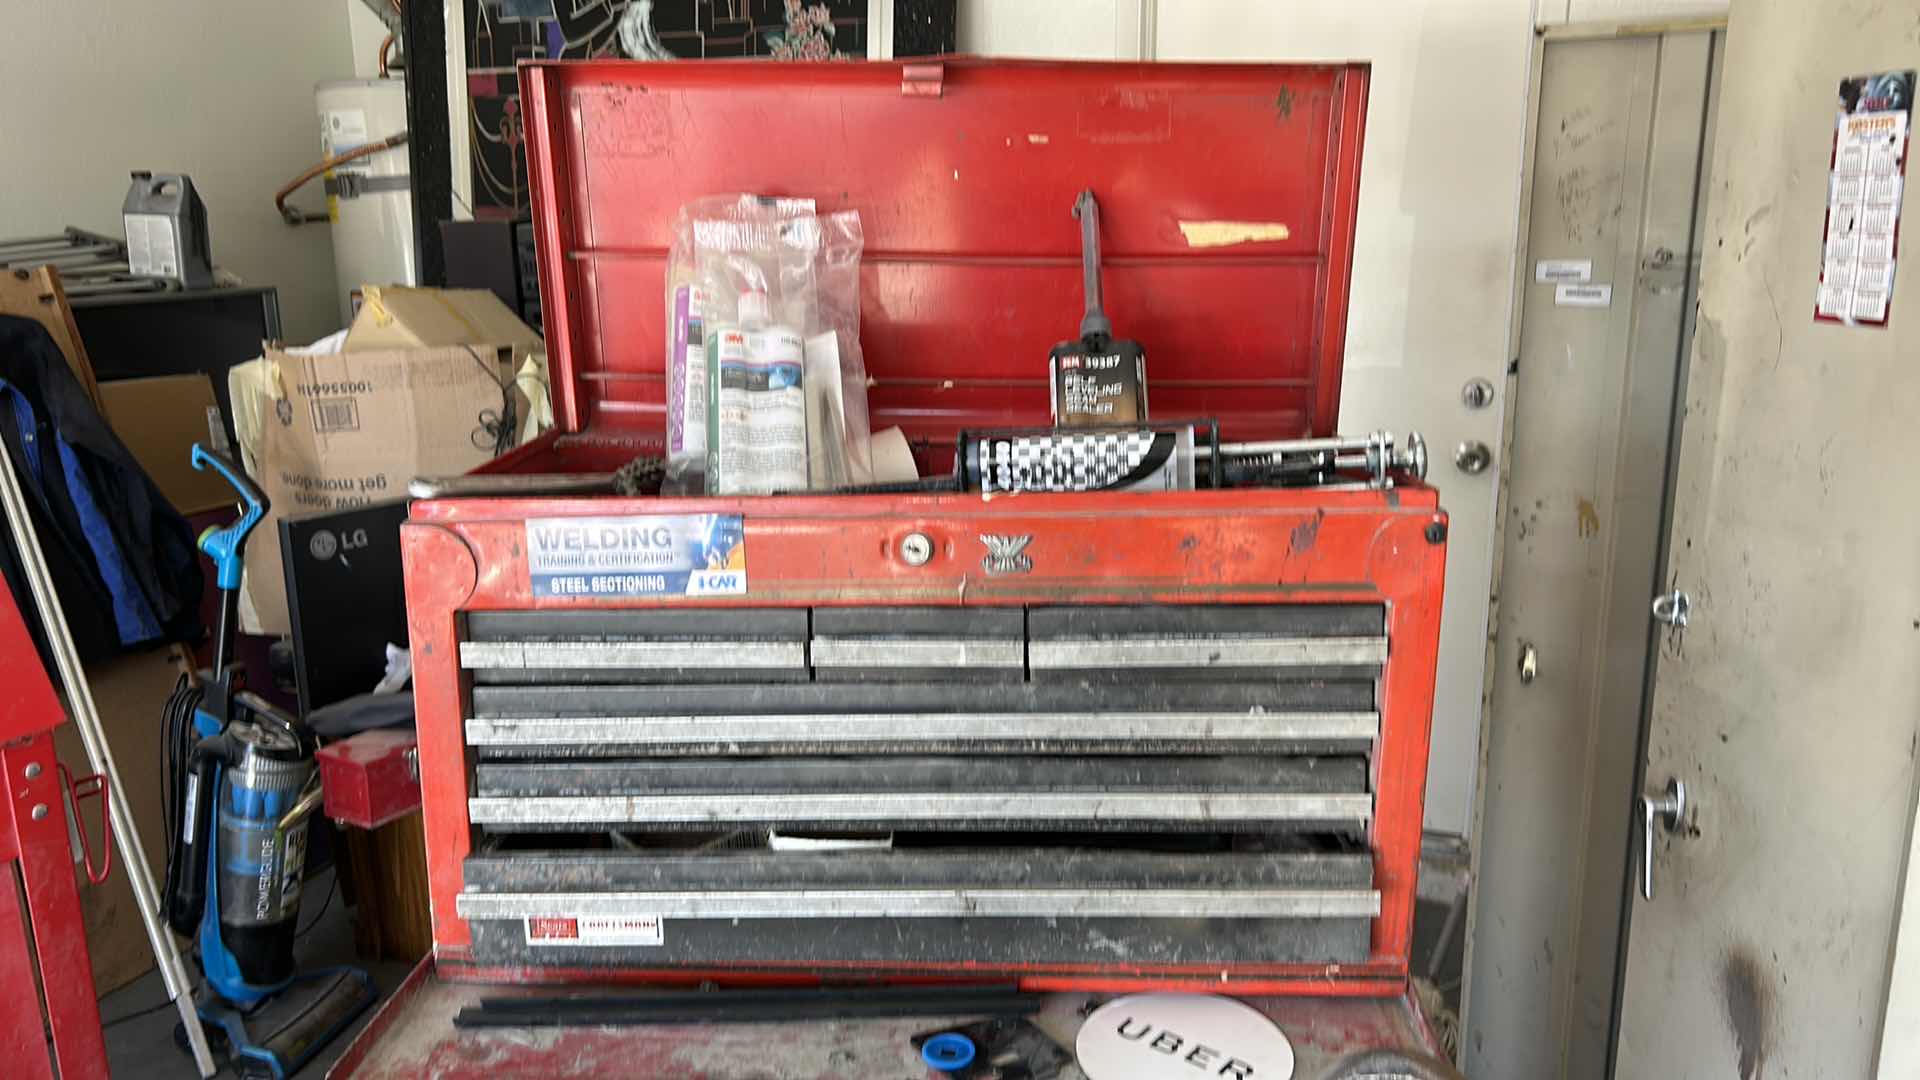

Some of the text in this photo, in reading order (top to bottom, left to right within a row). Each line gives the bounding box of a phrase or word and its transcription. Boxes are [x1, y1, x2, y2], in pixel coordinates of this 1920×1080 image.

[315, 477, 355, 490] more
[360, 473, 387, 493] get
[341, 528, 369, 549] LG
[534, 527, 673, 551] WELDING
[551, 575, 666, 593] STEEL SECTIONING
[1116, 1016, 1254, 1080] UBER
